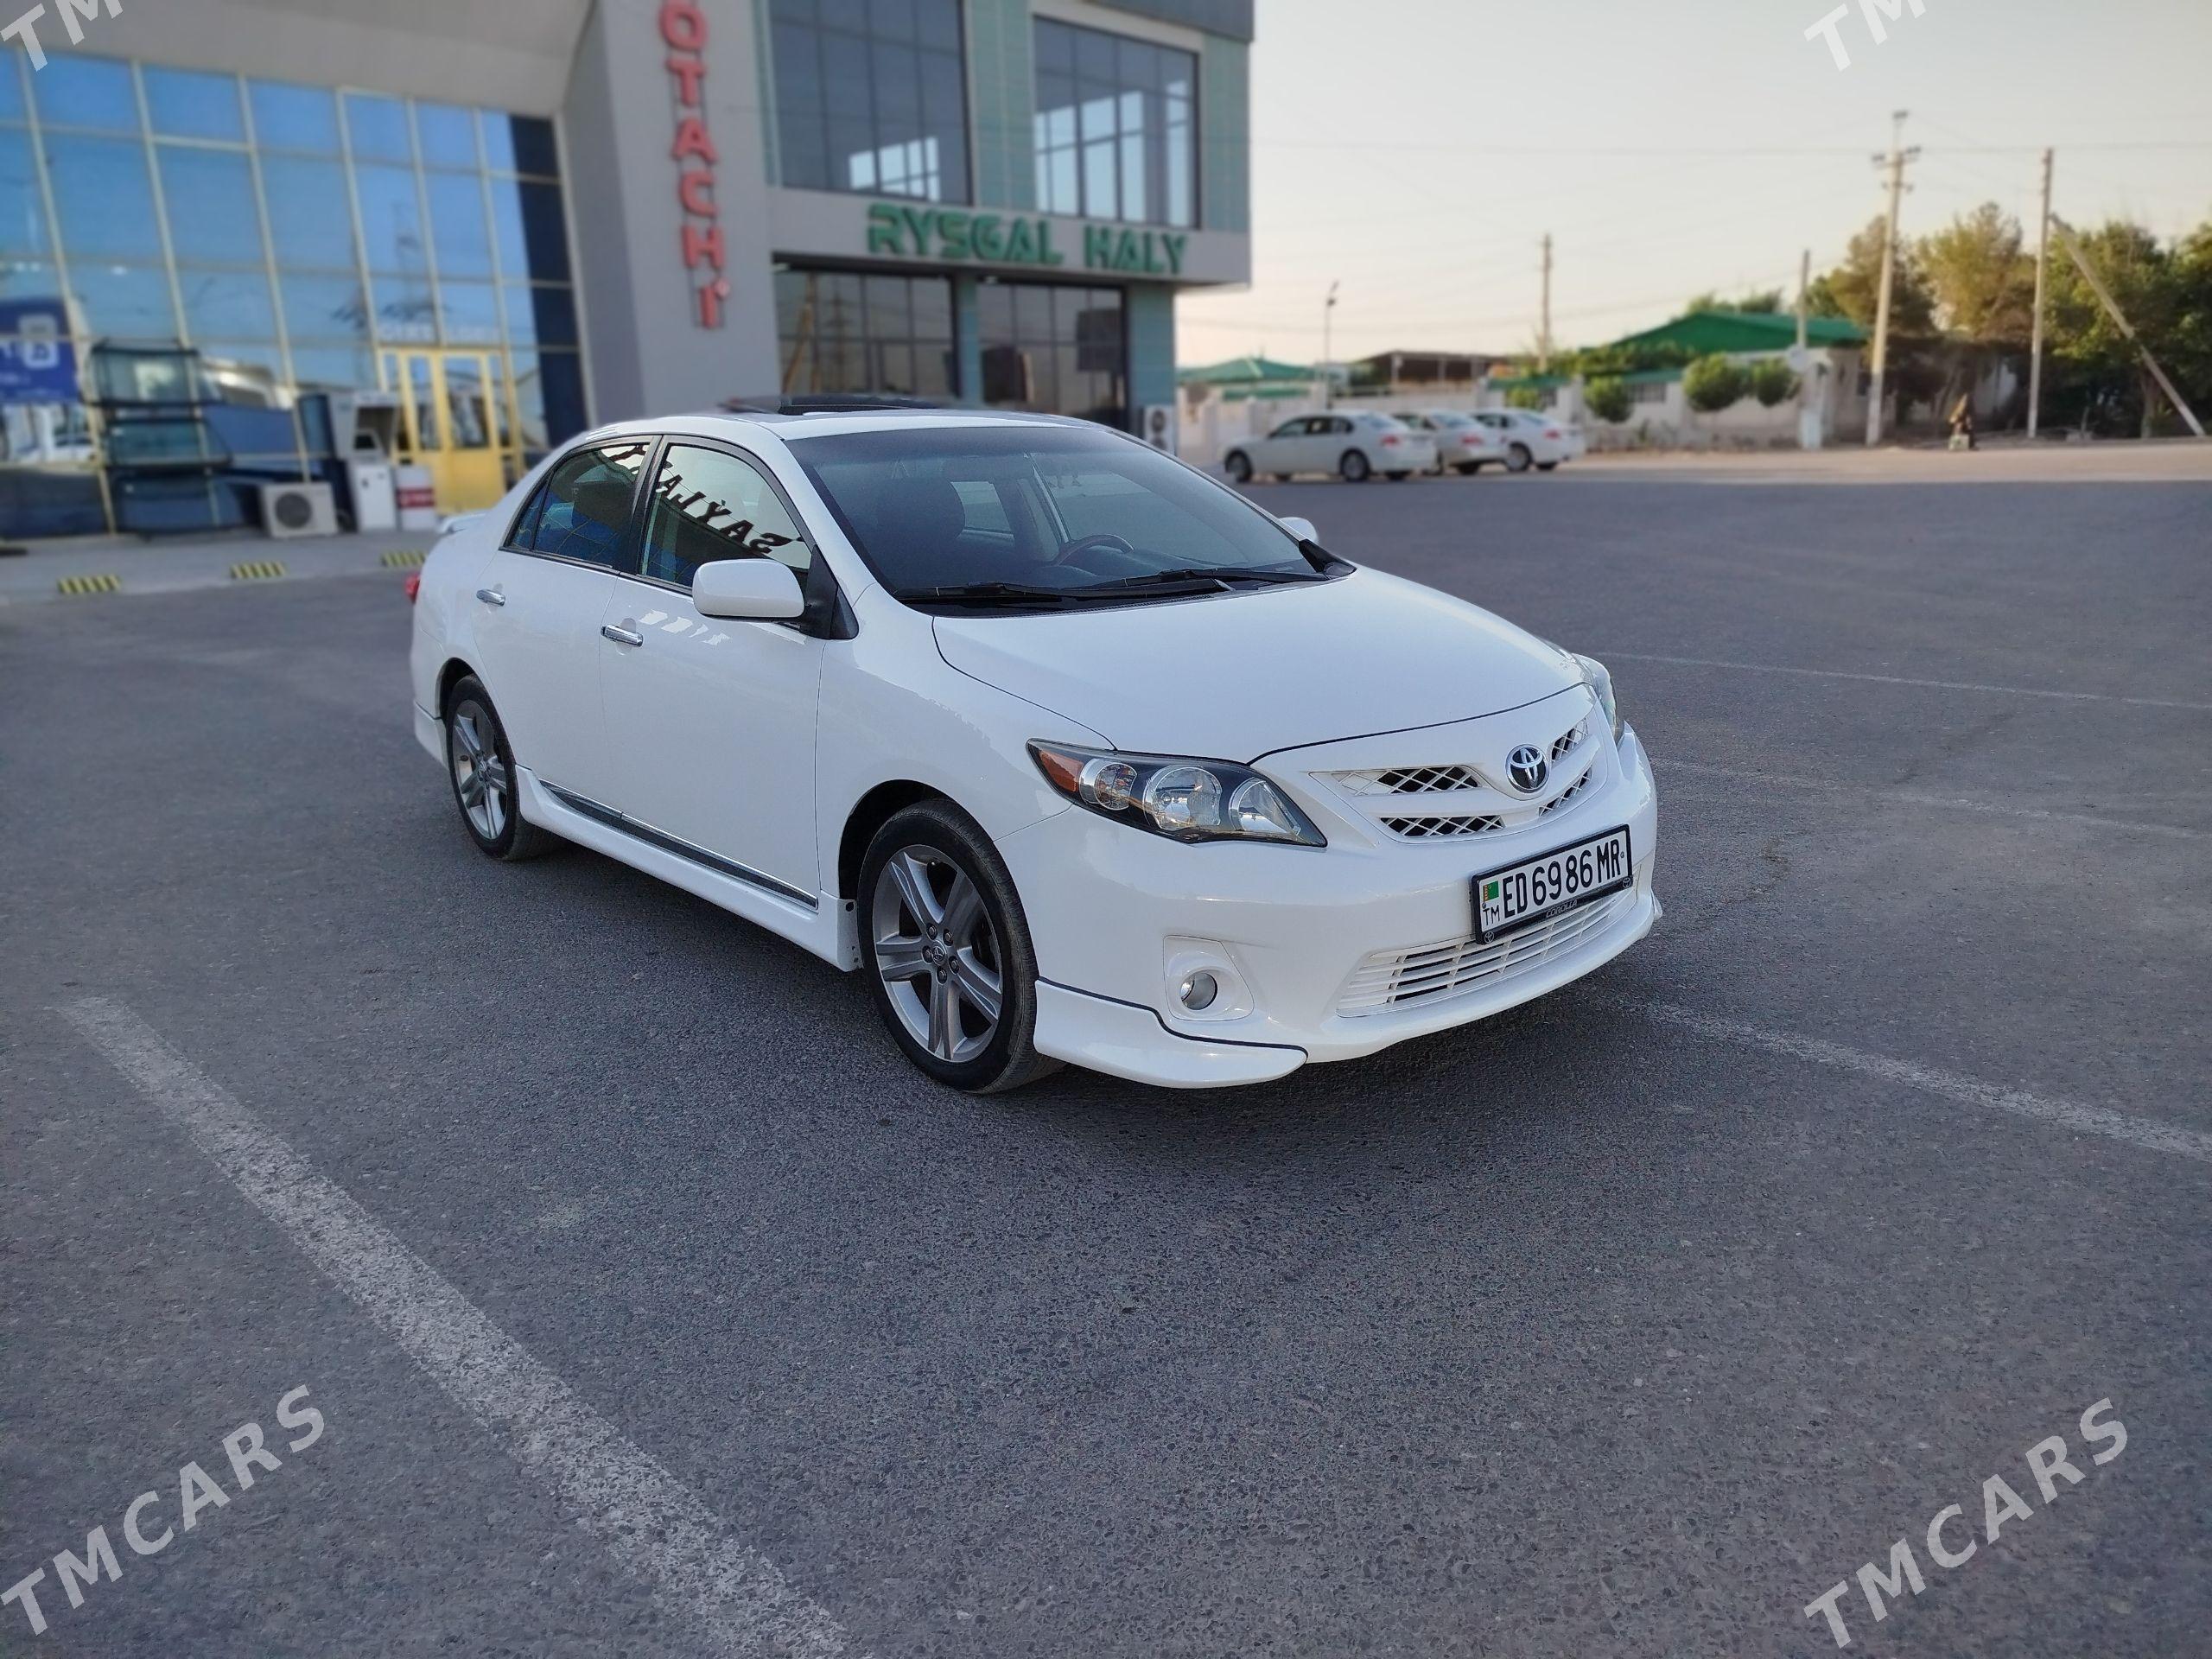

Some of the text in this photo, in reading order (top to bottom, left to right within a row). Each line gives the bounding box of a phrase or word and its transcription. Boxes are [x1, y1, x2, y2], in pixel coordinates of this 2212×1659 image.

[868, 202, 1187, 275] RYSGAL HALY
[1483, 905, 1500, 926] TM
[1546, 899, 1578, 918] COROLLA
